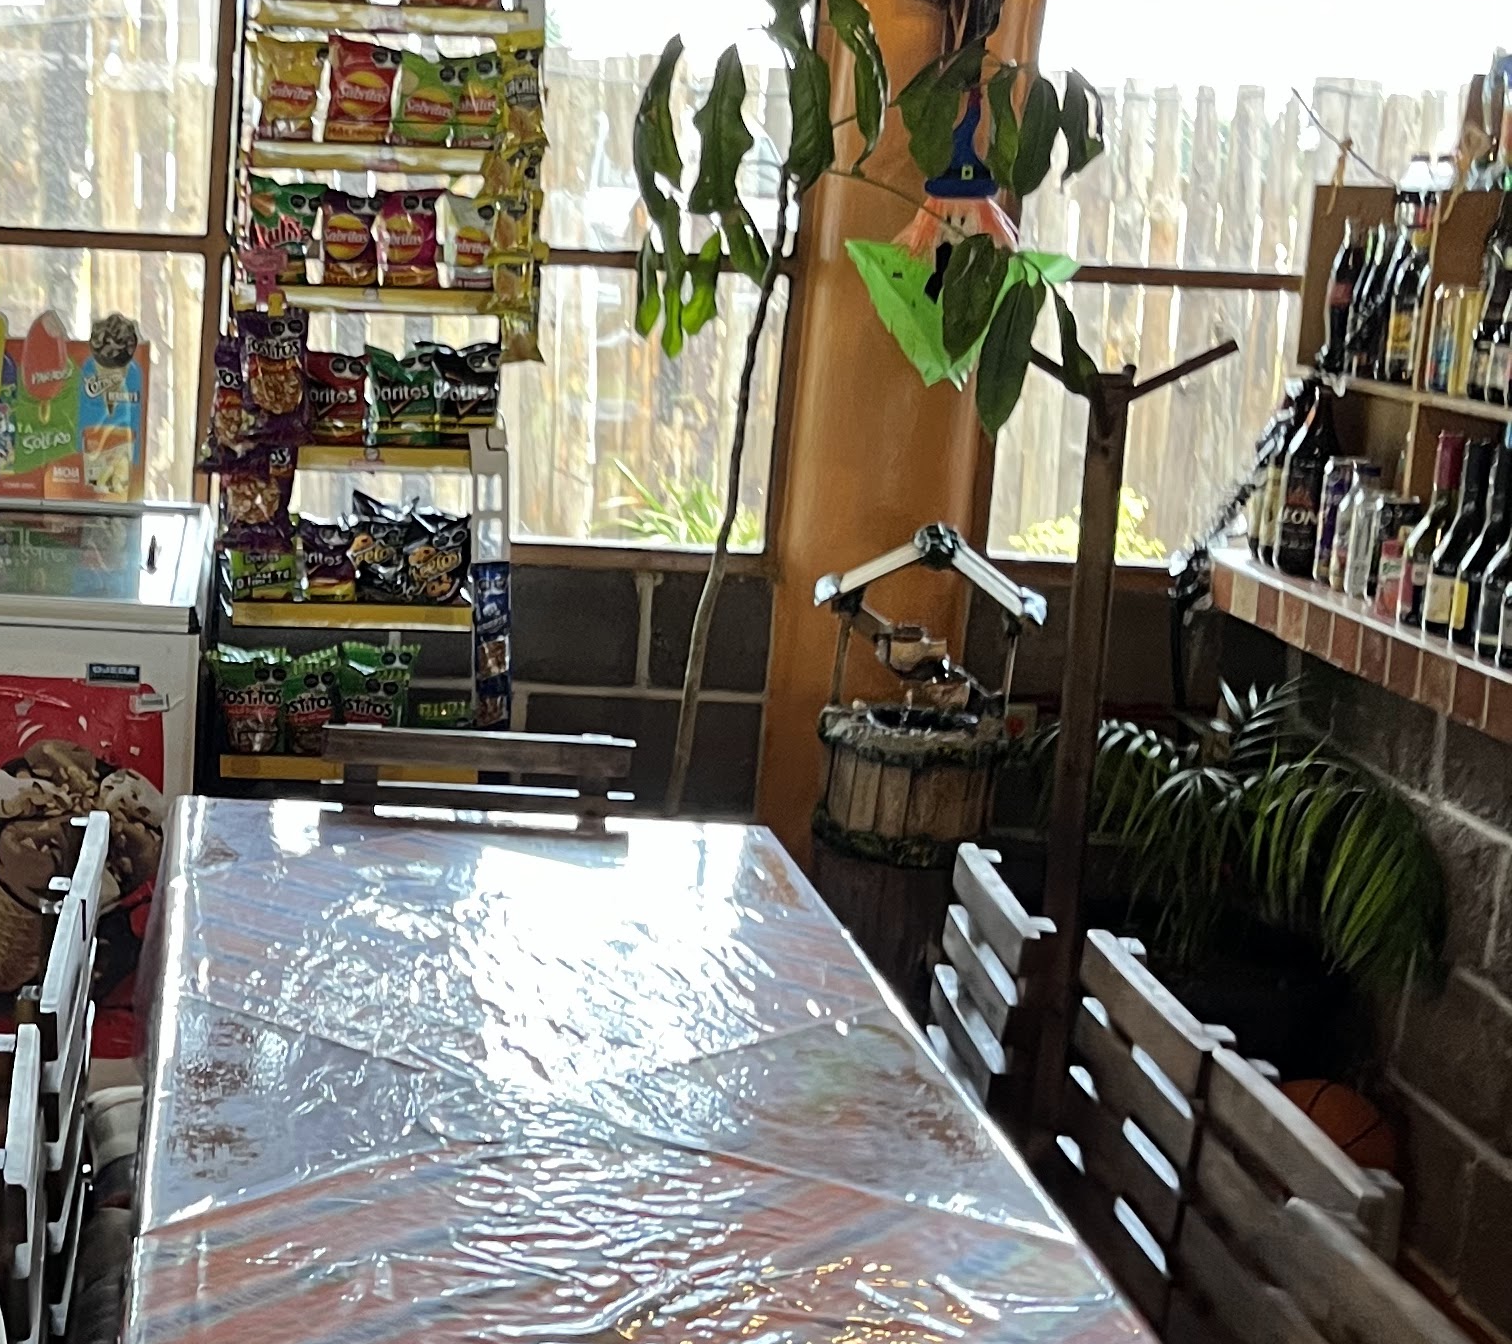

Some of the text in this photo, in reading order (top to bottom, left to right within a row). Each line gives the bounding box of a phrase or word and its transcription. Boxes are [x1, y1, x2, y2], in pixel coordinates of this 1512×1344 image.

[338, 80, 389, 105] Sabritas
[406, 98, 452, 118] Sabritas
[308, 386, 358, 404] oritos
[302, 550, 343, 567] oritos
[91, 664, 138, 676] OJEDA
